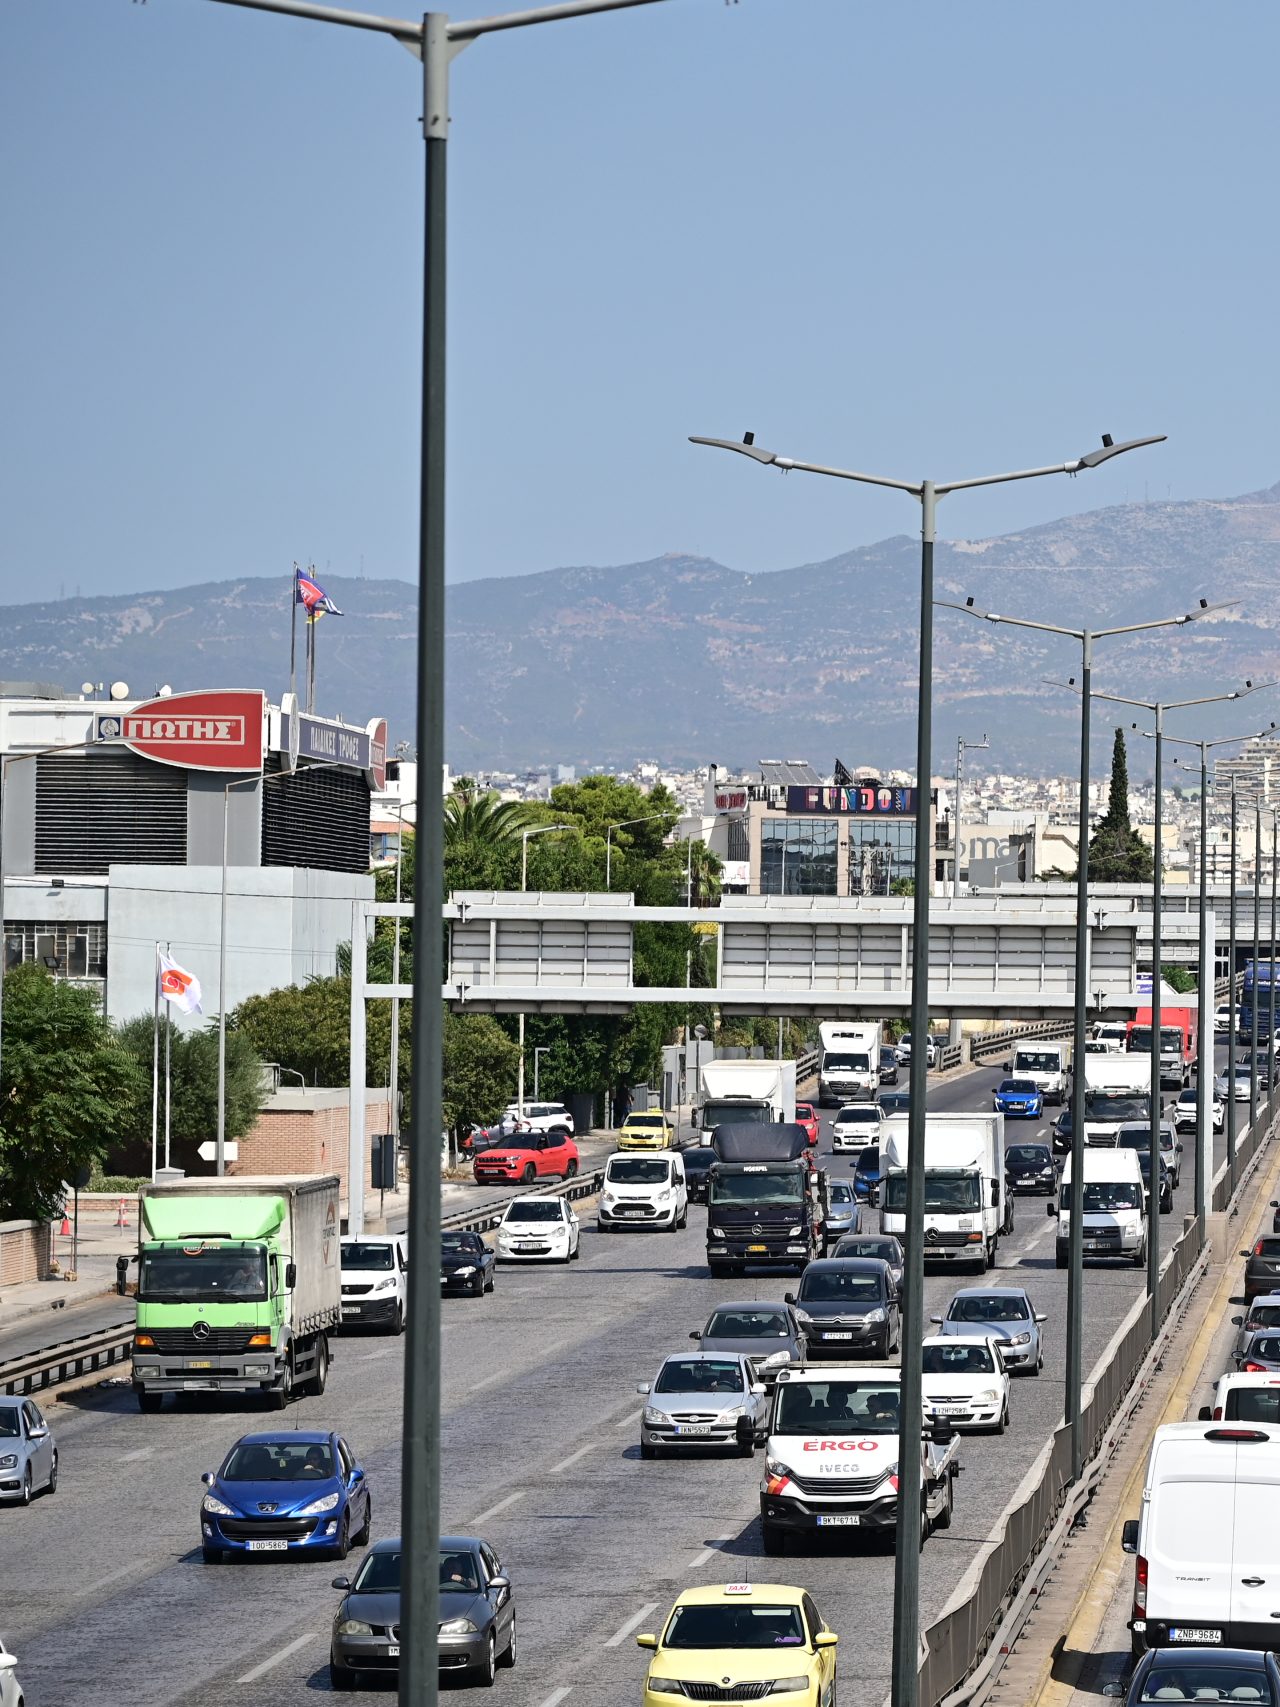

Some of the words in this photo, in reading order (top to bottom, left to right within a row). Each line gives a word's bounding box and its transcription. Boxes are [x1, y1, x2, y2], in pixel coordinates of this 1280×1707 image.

[128, 720, 231, 738] ΓΙΩΤΗΣ
[338, 733, 359, 761] ΤΡΟΦΕΣ
[803, 1441, 879, 1451] ERGO
[820, 1464, 859, 1472] IVECO
